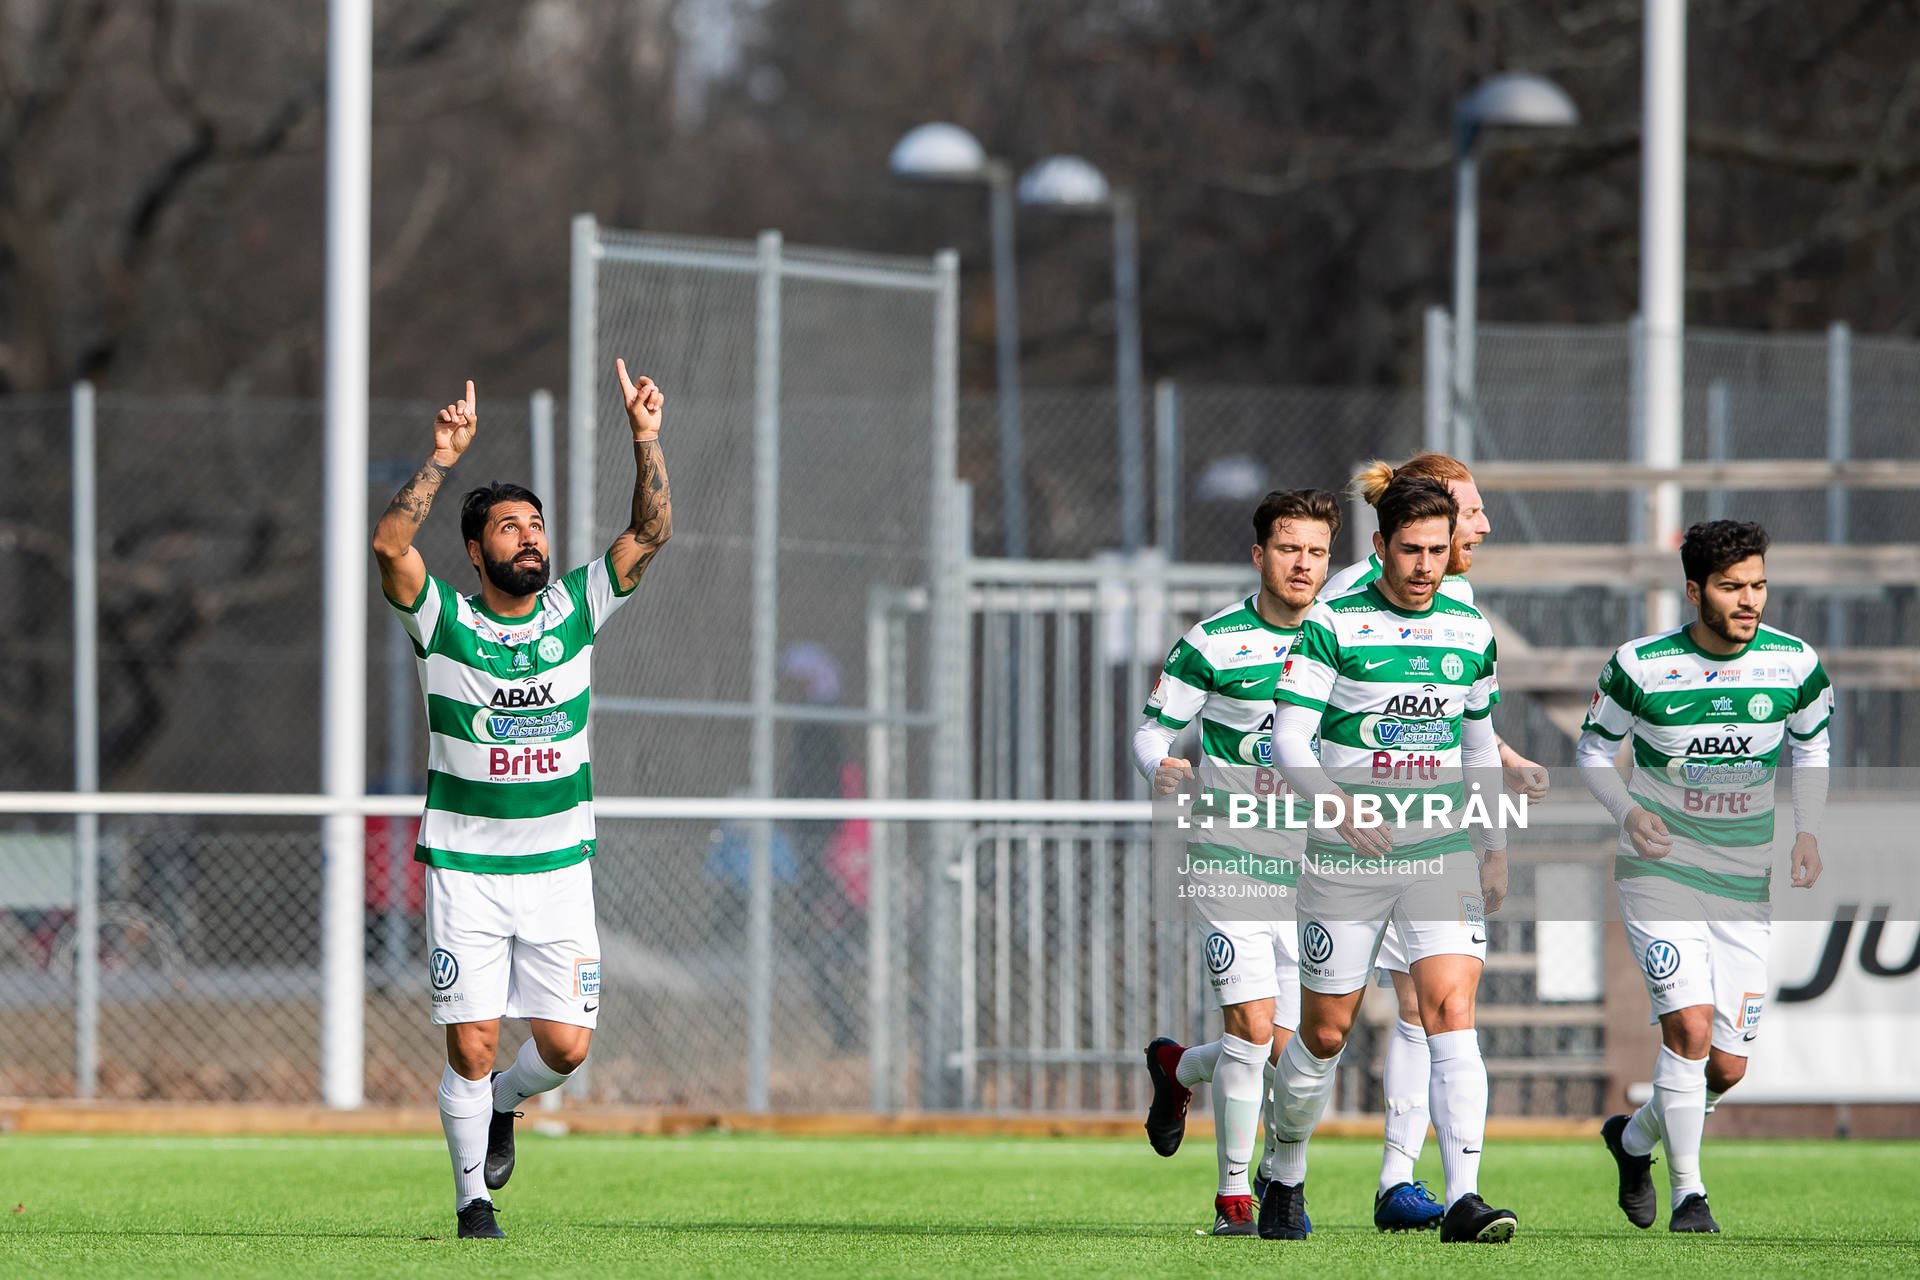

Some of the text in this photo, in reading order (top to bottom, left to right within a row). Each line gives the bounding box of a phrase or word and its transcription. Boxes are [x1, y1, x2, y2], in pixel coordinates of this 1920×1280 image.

[490, 682, 556, 708] ABAX
[1384, 695, 1449, 717] ABAX
[1686, 736, 1753, 755] ABAX
[490, 747, 561, 775] Britt
[1372, 751, 1441, 780] Britt
[1684, 788, 1751, 814] Britt
